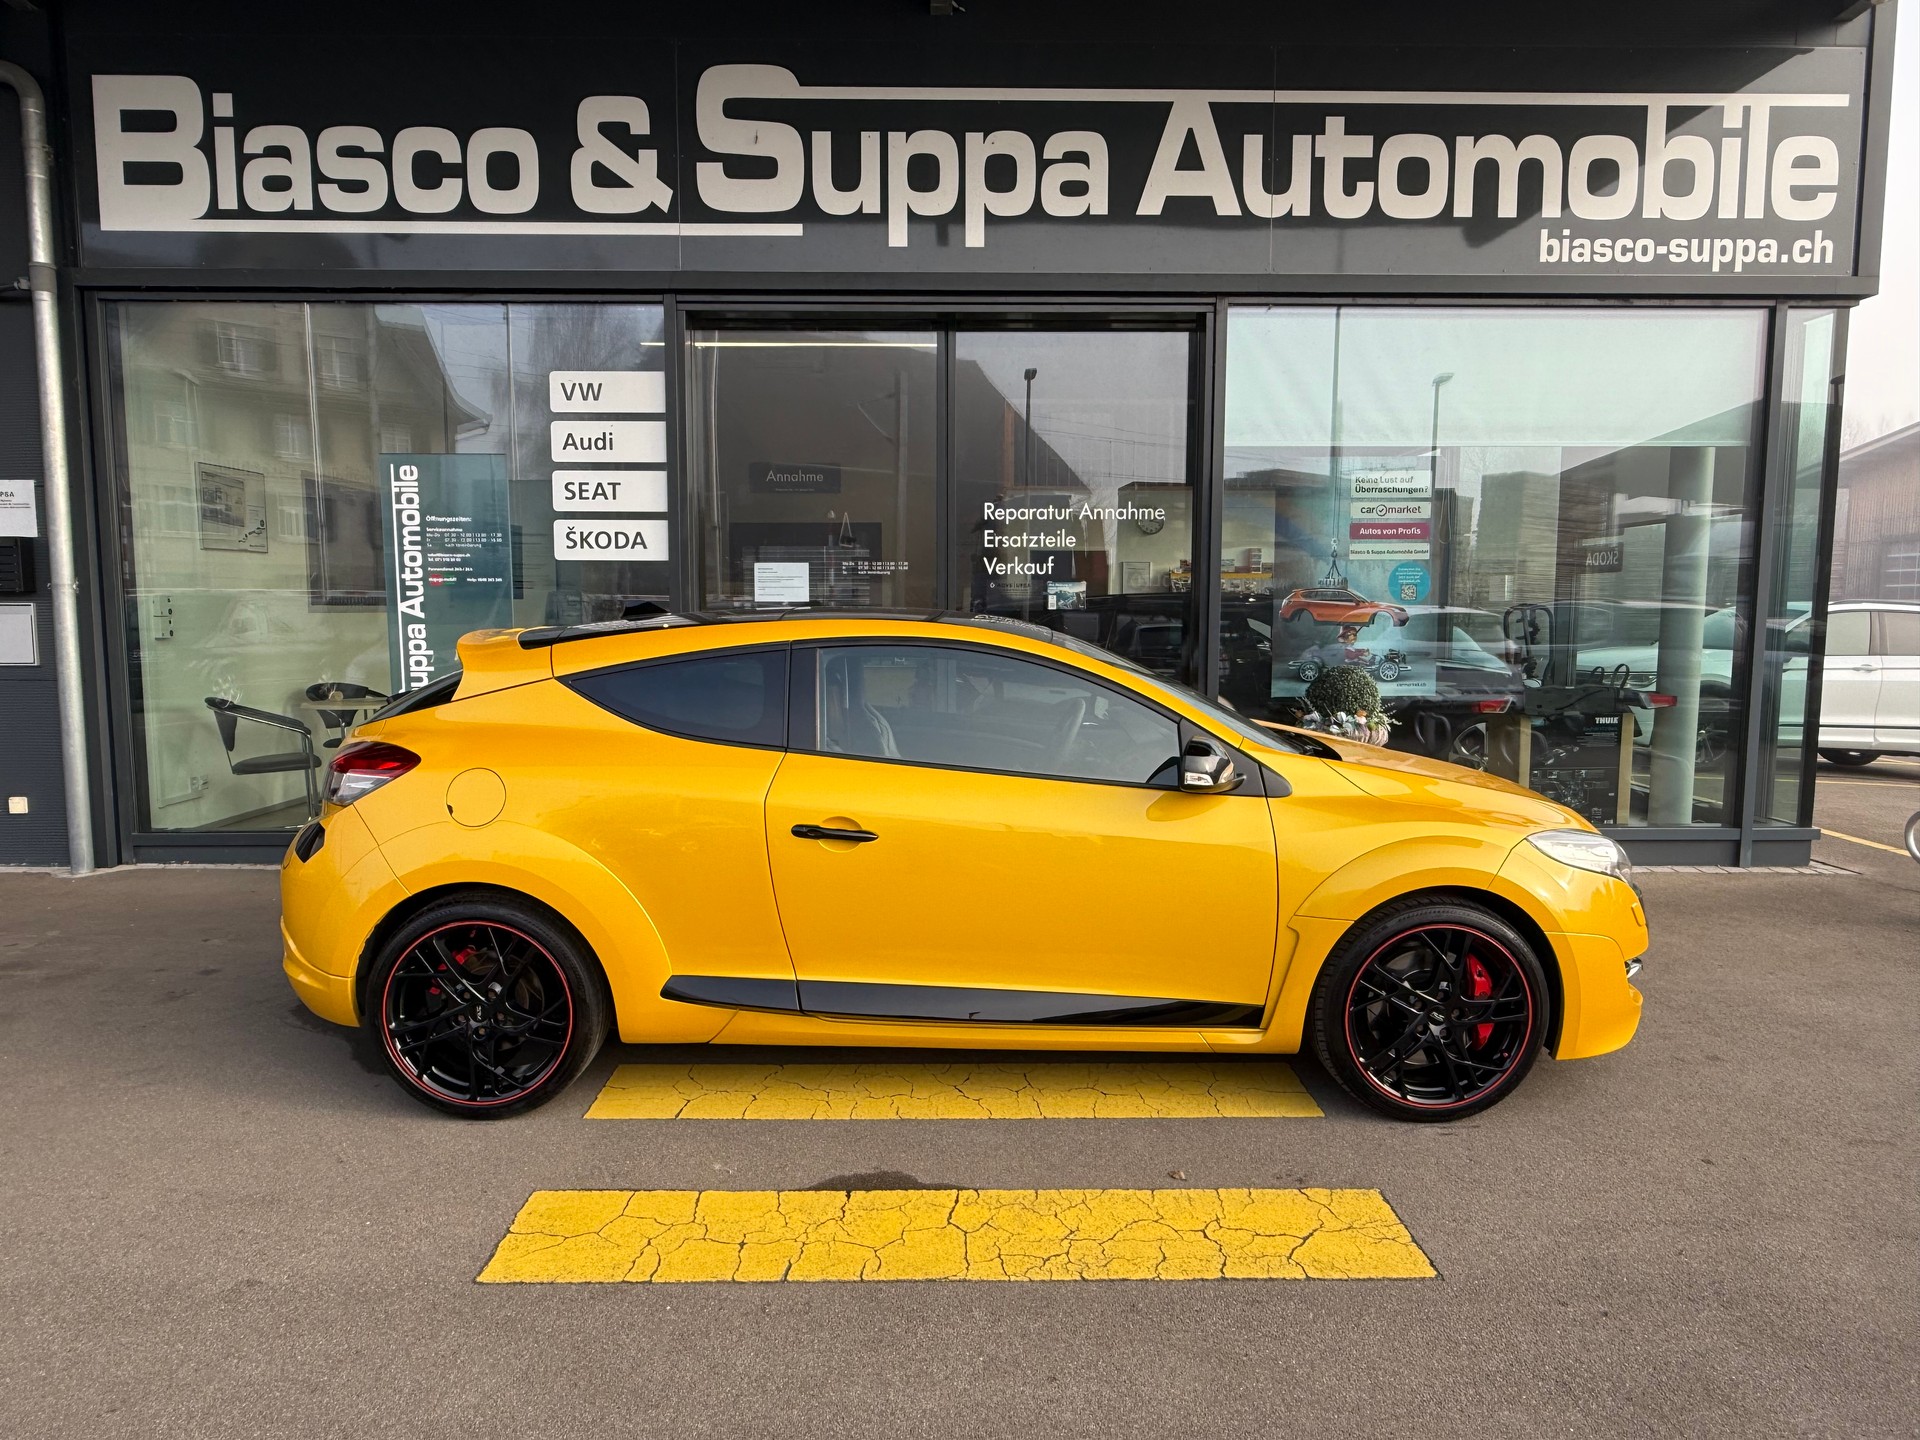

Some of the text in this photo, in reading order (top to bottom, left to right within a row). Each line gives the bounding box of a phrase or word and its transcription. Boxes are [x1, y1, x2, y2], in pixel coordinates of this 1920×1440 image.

[92, 63, 1840, 248] Biasco & Suppa Automobile
[1538, 229, 1834, 272] biasco-suppa.ch
[560, 382, 603, 401] VW
[562, 431, 614, 450] Audi
[766, 469, 824, 482] Annahme
[1355, 475, 1414, 484] Keine Lust auf
[564, 481, 621, 500] SEAT
[1355, 484, 1429, 495] Überraschungen?
[983, 501, 1166, 525] Reparatur Annahme
[565, 526, 648, 550] ŠKODA
[983, 528, 1077, 548] Ersatzteile
[1359, 527, 1381, 535] Autos
[1398, 527, 1421, 535] Profis
[396, 464, 426, 620] Automobile
[982, 555, 1055, 576] Verkauf
[406, 623, 435, 691] uppa
